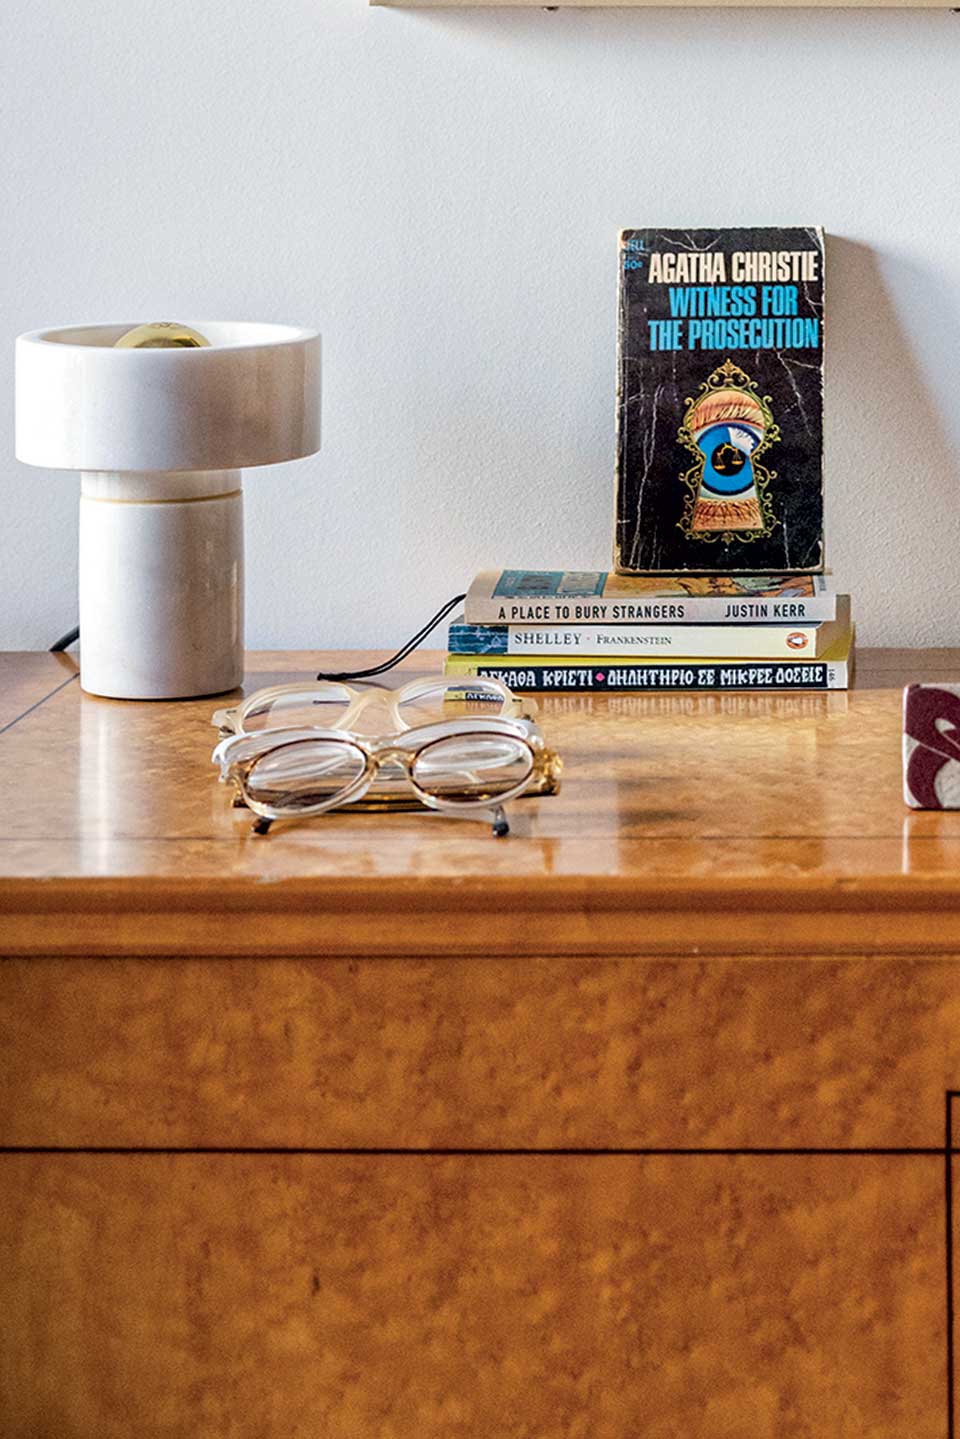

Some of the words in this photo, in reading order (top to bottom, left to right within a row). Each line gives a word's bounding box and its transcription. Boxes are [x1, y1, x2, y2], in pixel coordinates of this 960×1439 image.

[648, 252, 726, 283] AGATHA
[732, 250, 819, 282] CHRISTIE
[669, 286, 757, 317] WITNESS
[762, 285, 798, 316] FOR
[648, 319, 683, 351] THE
[688, 318, 819, 350] PROSECUTION
[498, 606, 506, 619] A
[511, 606, 550, 619] PLACE
[556, 606, 569, 618] TO
[575, 606, 607, 618] BURY
[613, 605, 685, 618] STRANGERS
[725, 605, 768, 618] JUSTIN
[773, 604, 805, 617] KERR
[514, 633, 582, 645] SHELLEY
[542, 670, 593, 686] ΚΡΙΣΤΙ
[607, 668, 694, 686] ΔΗΛΗΤΗΡΙΟ
[697, 668, 715, 684] ΣΕ
[720, 667, 773, 685] ΜΙΚΡΕΣ
[775, 666, 823, 684] ΔΟΣΕΙΣ
